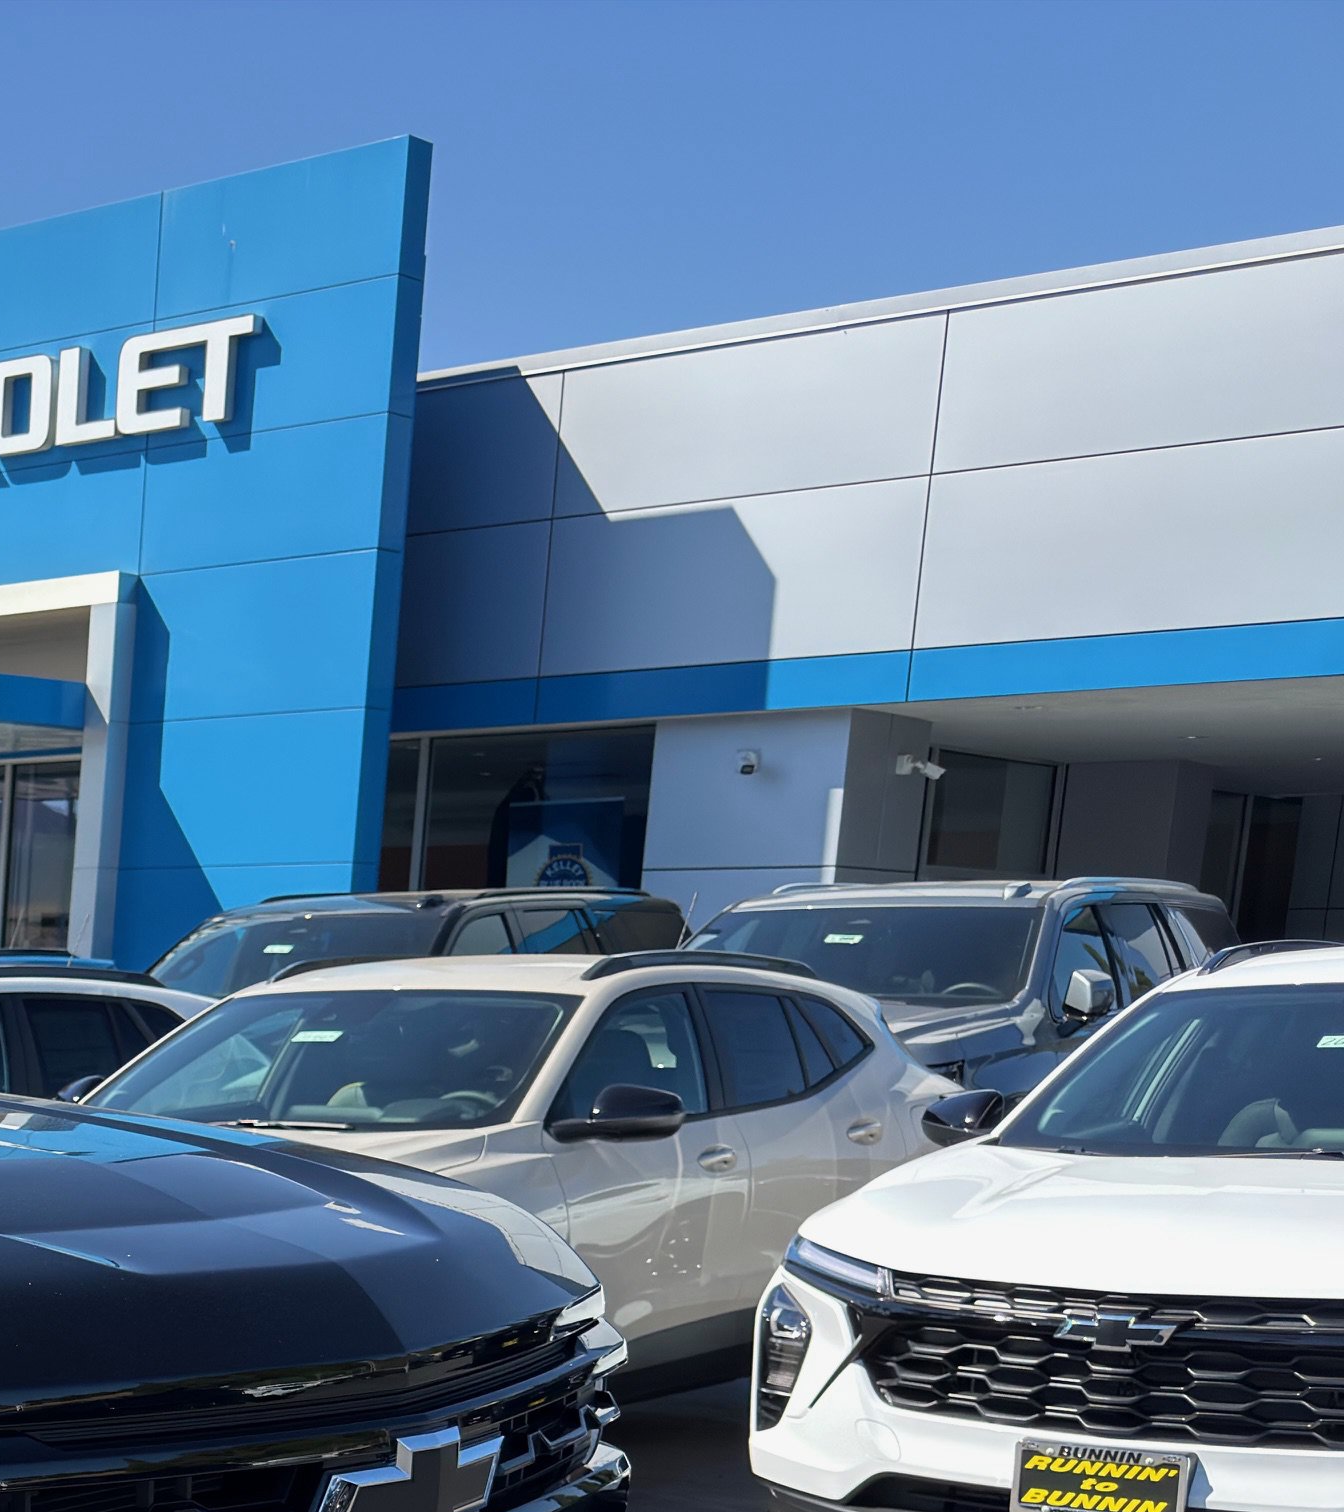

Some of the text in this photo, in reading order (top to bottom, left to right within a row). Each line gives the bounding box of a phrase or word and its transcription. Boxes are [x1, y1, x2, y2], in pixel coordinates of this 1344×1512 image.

[1057, 1446, 1143, 1464] BUNNIN
[1024, 1455, 1180, 1483] RUNNIN'
[1079, 1477, 1119, 1492] to
